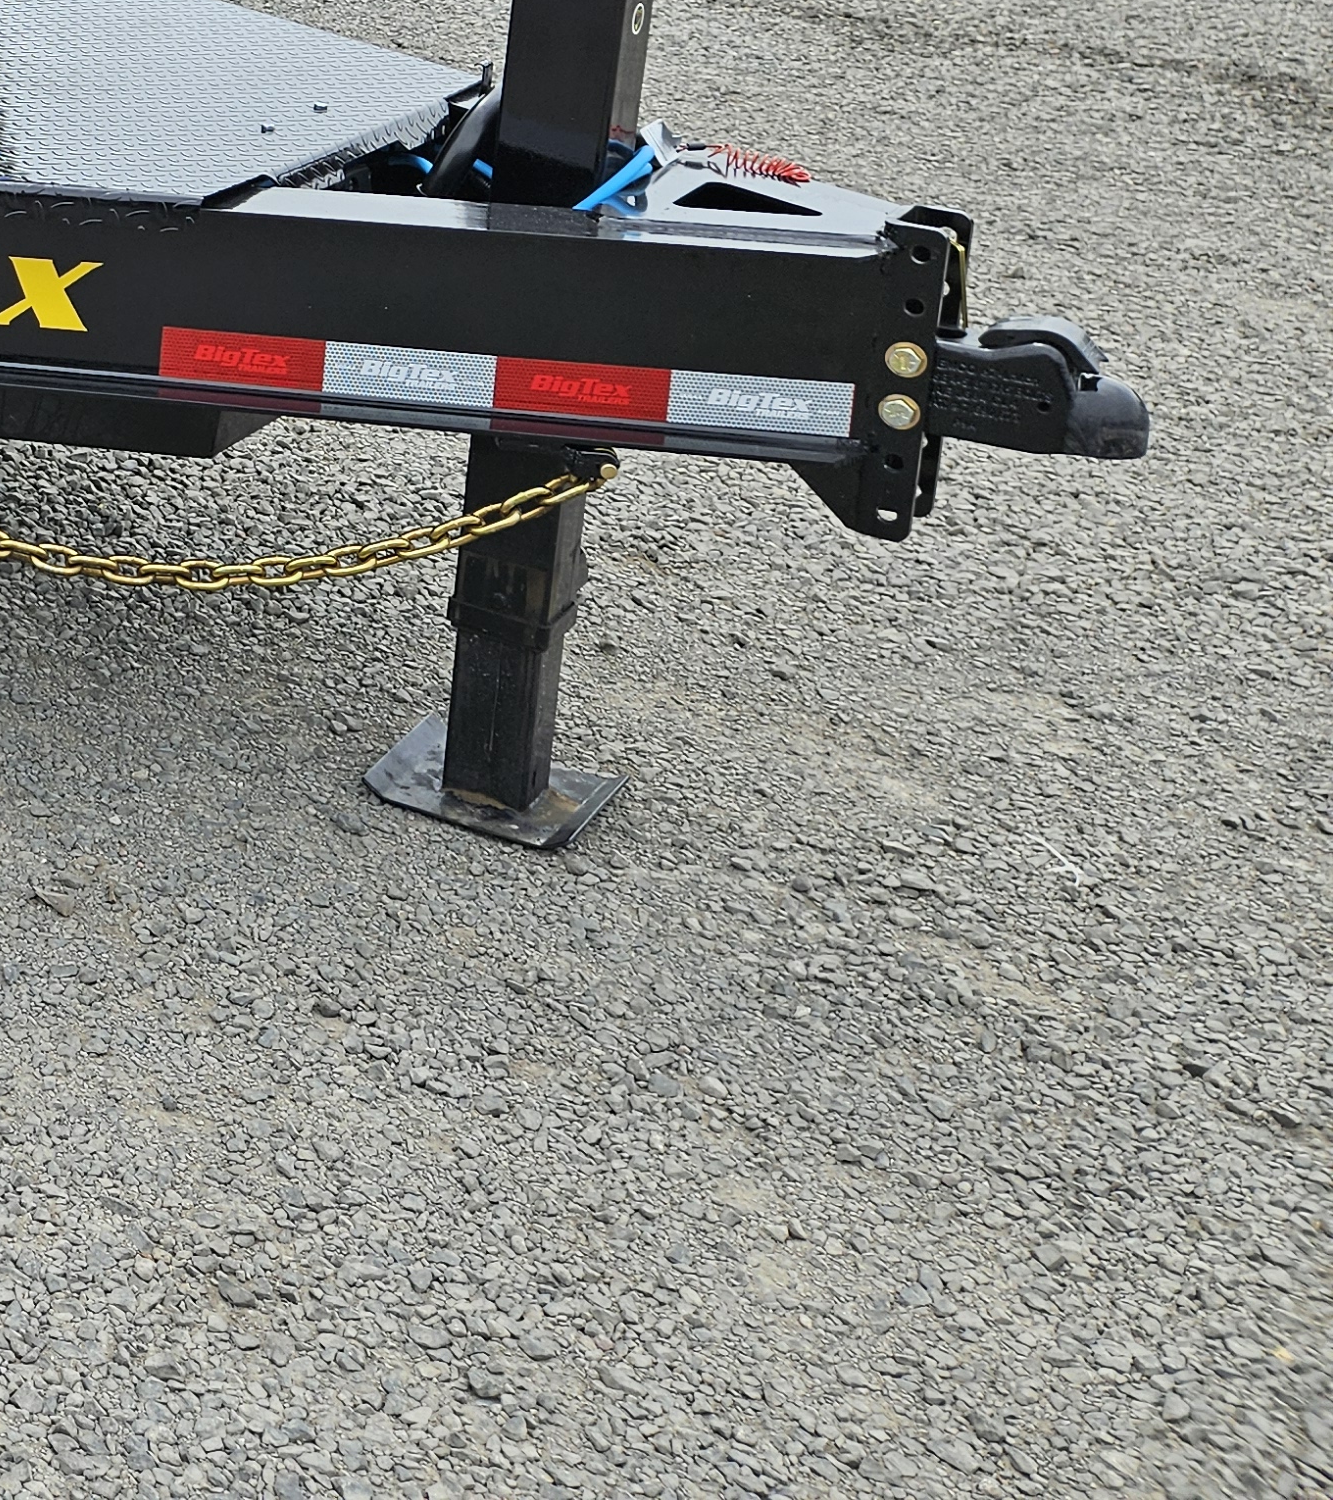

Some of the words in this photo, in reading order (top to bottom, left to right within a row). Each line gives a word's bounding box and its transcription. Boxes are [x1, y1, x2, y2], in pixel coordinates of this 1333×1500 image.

[193, 344, 291, 367] BigTex
[360, 358, 459, 383] BigTex
[530, 374, 633, 398] BigTex
[707, 387, 813, 412] BigTex
